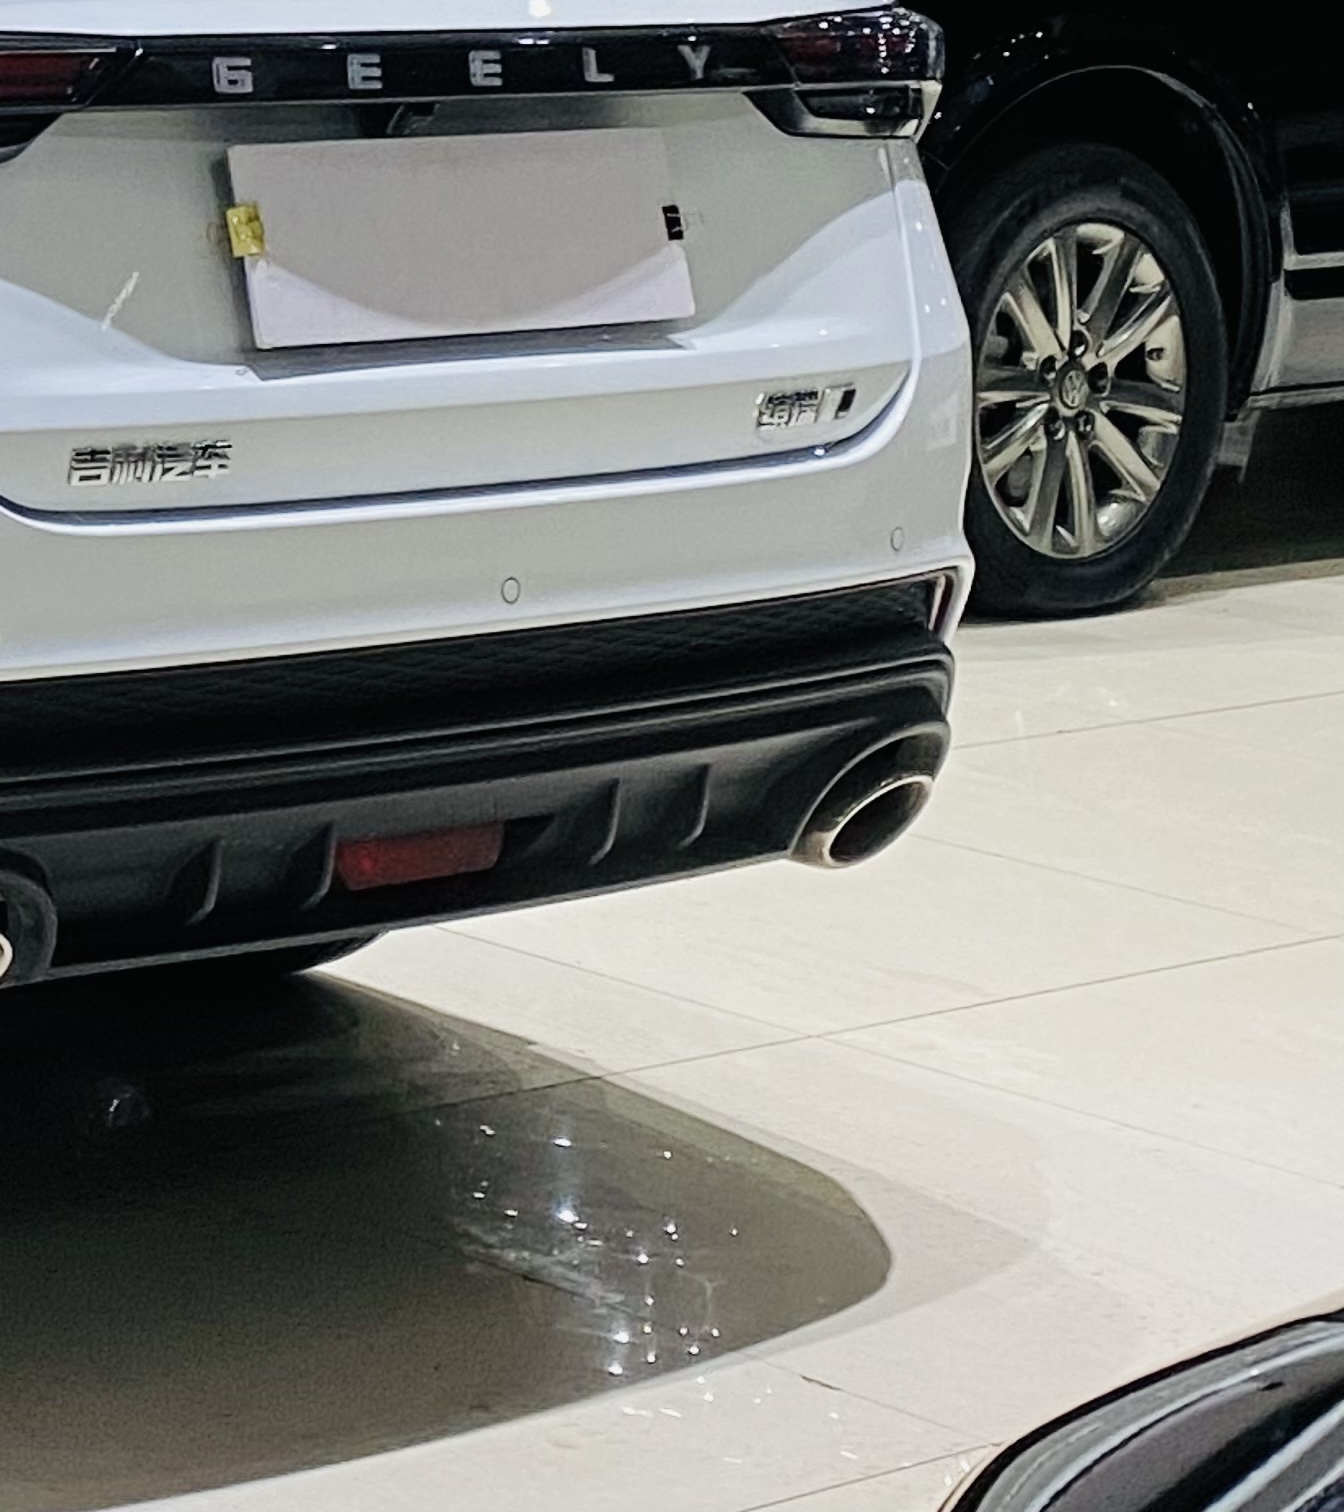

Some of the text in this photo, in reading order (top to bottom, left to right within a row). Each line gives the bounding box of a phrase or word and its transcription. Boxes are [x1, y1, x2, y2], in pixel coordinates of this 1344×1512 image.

[212, 44, 711, 94] GEELY
[69, 440, 232, 487] 吉利汽车
